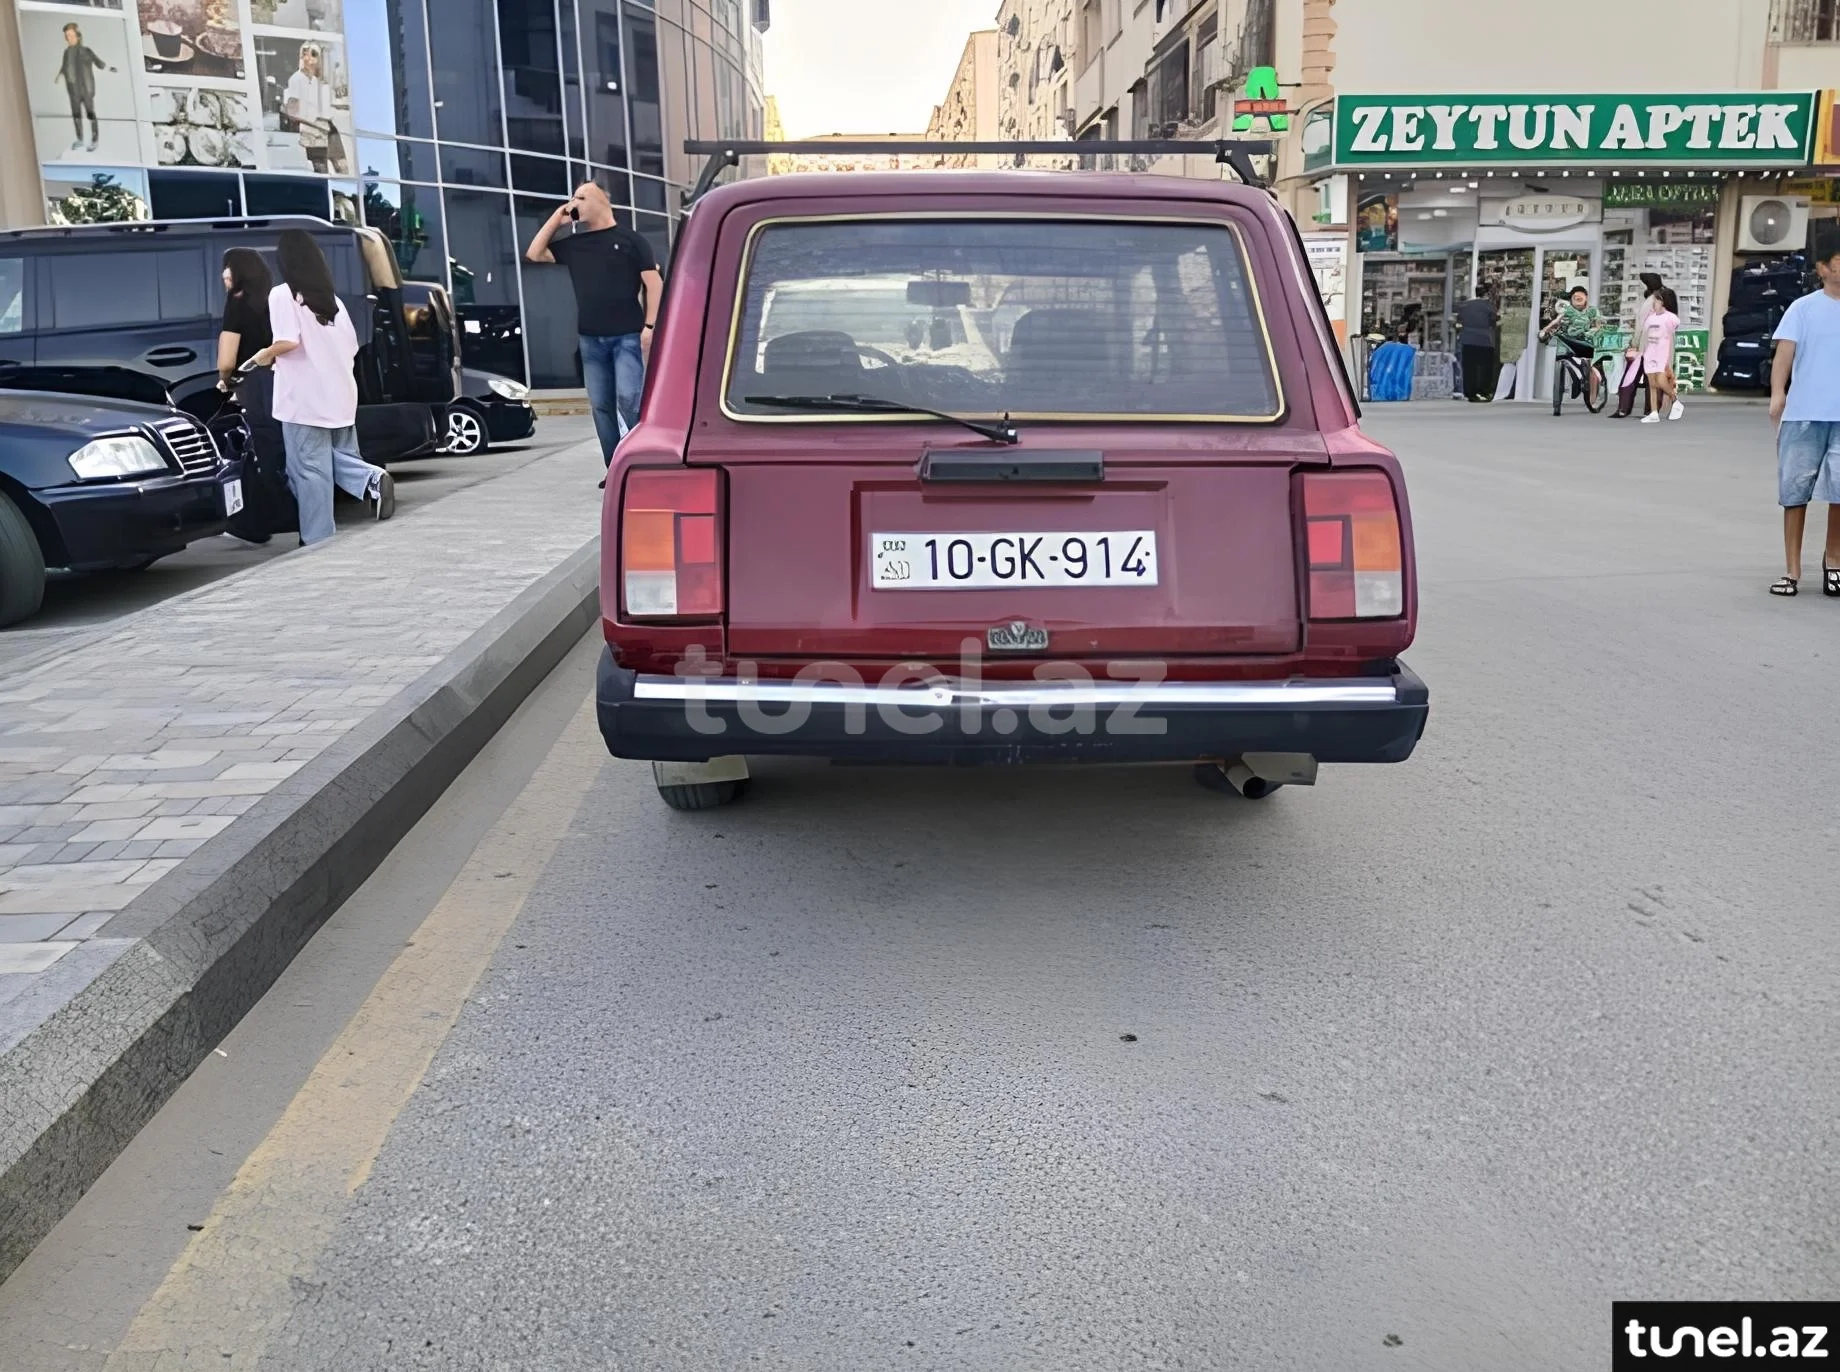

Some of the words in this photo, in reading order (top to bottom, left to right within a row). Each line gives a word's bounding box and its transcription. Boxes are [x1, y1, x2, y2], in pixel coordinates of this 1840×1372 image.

[1350, 105, 1594, 151] ZEYTUN
[1600, 104, 1799, 150] APTEK
[925, 537, 1150, 580] 10-GK-914
